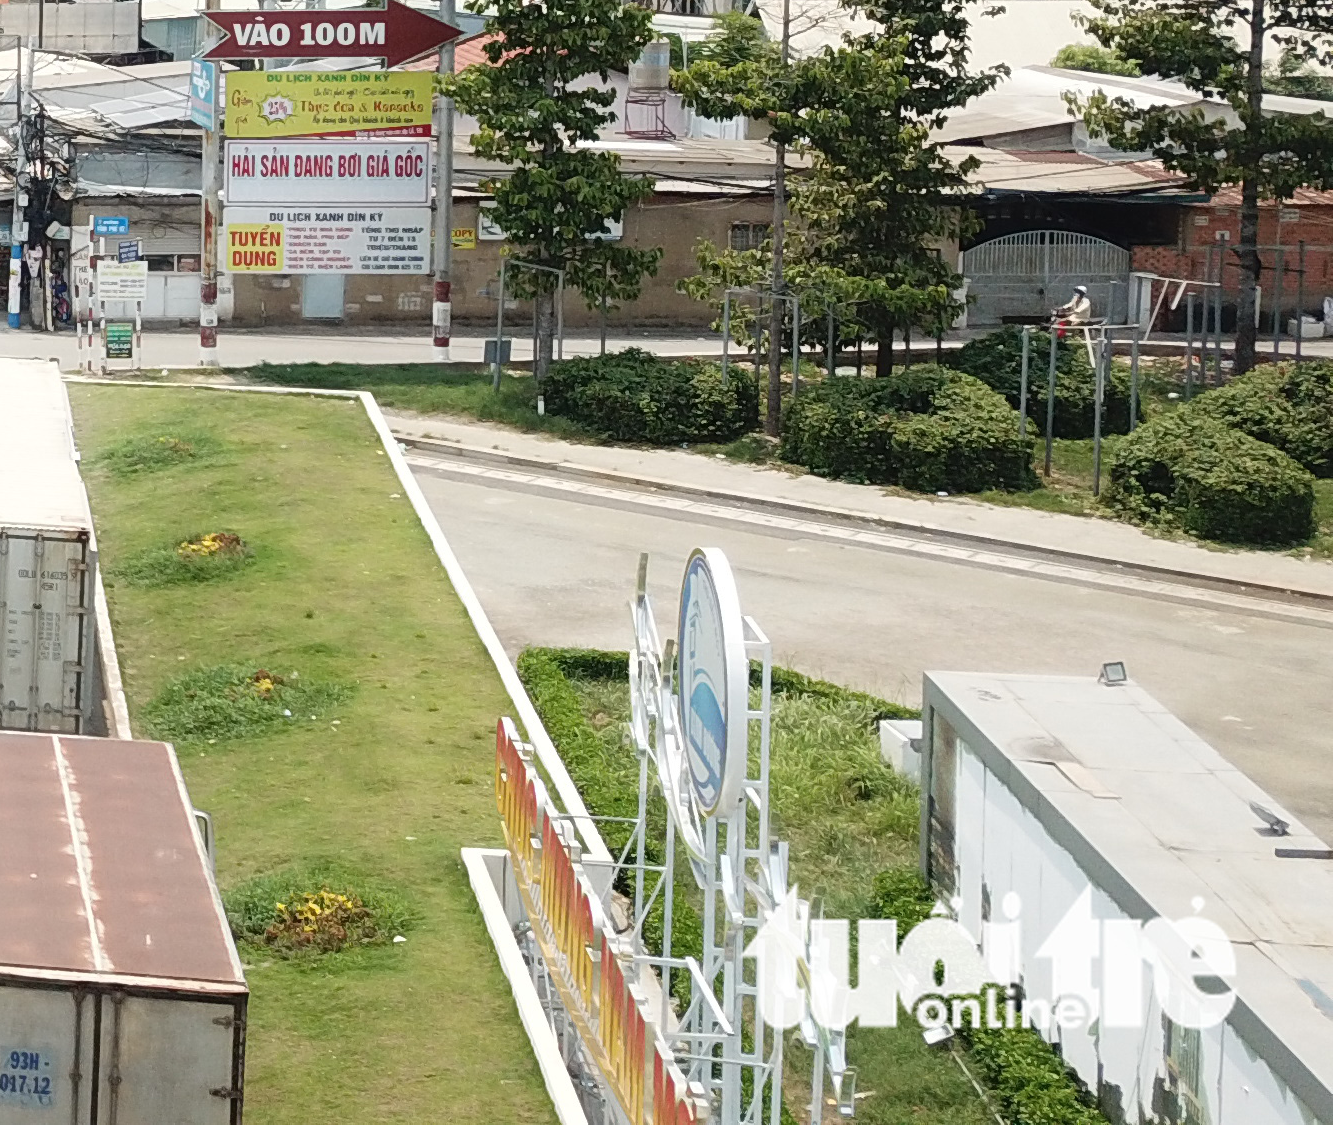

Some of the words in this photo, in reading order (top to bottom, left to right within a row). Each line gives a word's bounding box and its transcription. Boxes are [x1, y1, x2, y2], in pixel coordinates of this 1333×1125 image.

[233, 14, 291, 48] VÀO
[299, 20, 386, 48] 100M
[267, 74, 282, 82] DU
[286, 74, 312, 84] LỊCH
[317, 73, 347, 82] XANH
[359, 102, 368, 113] &
[374, 101, 424, 113] Karaoke
[232, 146, 256, 178] HẢI
[260, 146, 290, 178] SẢN
[294, 154, 333, 178] ĐANG
[337, 151, 362, 177] BƠI
[366, 149, 390, 178] GIÁ
[394, 146, 424, 178] GỐC
[269, 212, 284, 222] DU
[287, 212, 311, 224] LỊCH
[314, 212, 344, 222] XANH
[229, 225, 281, 247] TUYỂN
[232, 251, 277, 271] DỤNG
[10, 1050, 40, 1071] 93H
[0, 1073, 52, 1095] 017.12
